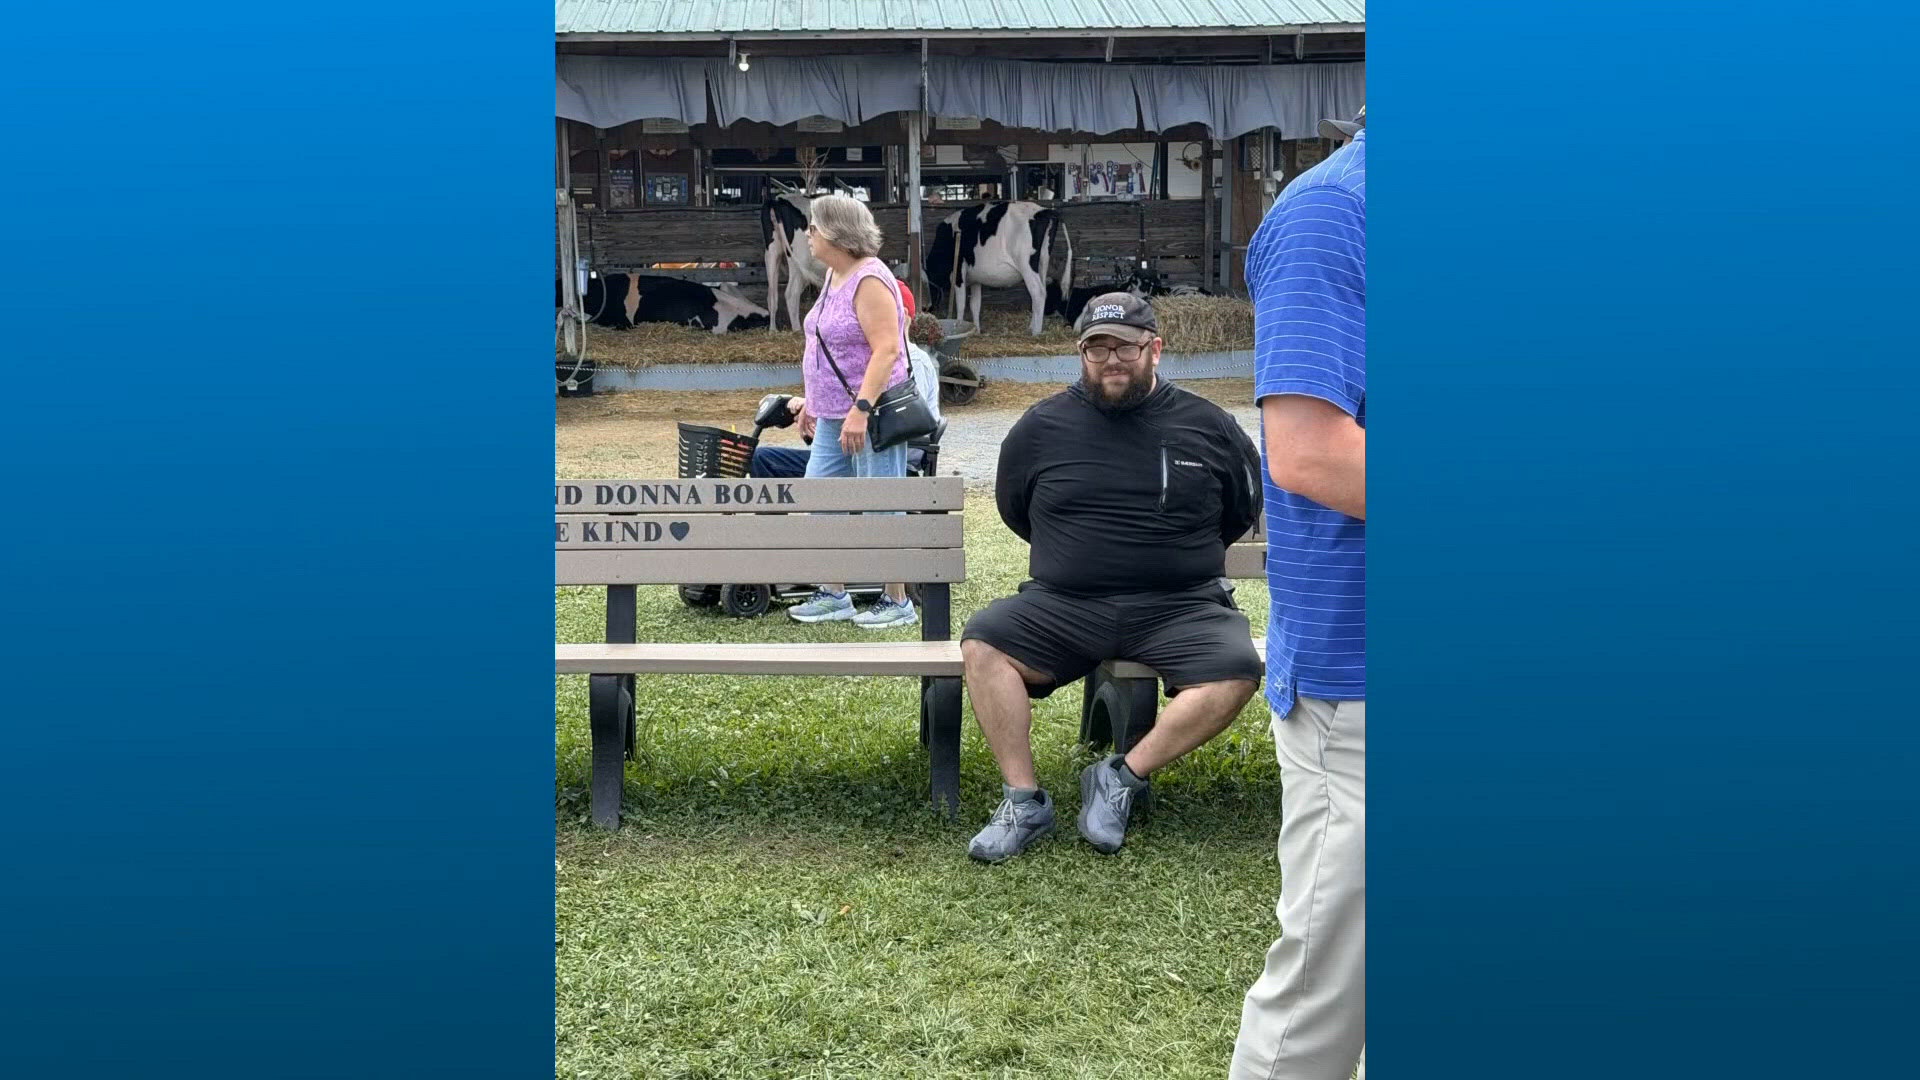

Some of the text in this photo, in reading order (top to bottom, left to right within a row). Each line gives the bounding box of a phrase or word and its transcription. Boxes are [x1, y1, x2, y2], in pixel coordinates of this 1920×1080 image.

[1091, 311, 1125, 321] RESPECT
[1094, 304, 1125, 313] HONOR
[595, 484, 702, 505] DONNA
[714, 483, 796, 505] BOAK
[582, 521, 663, 542] KIND
